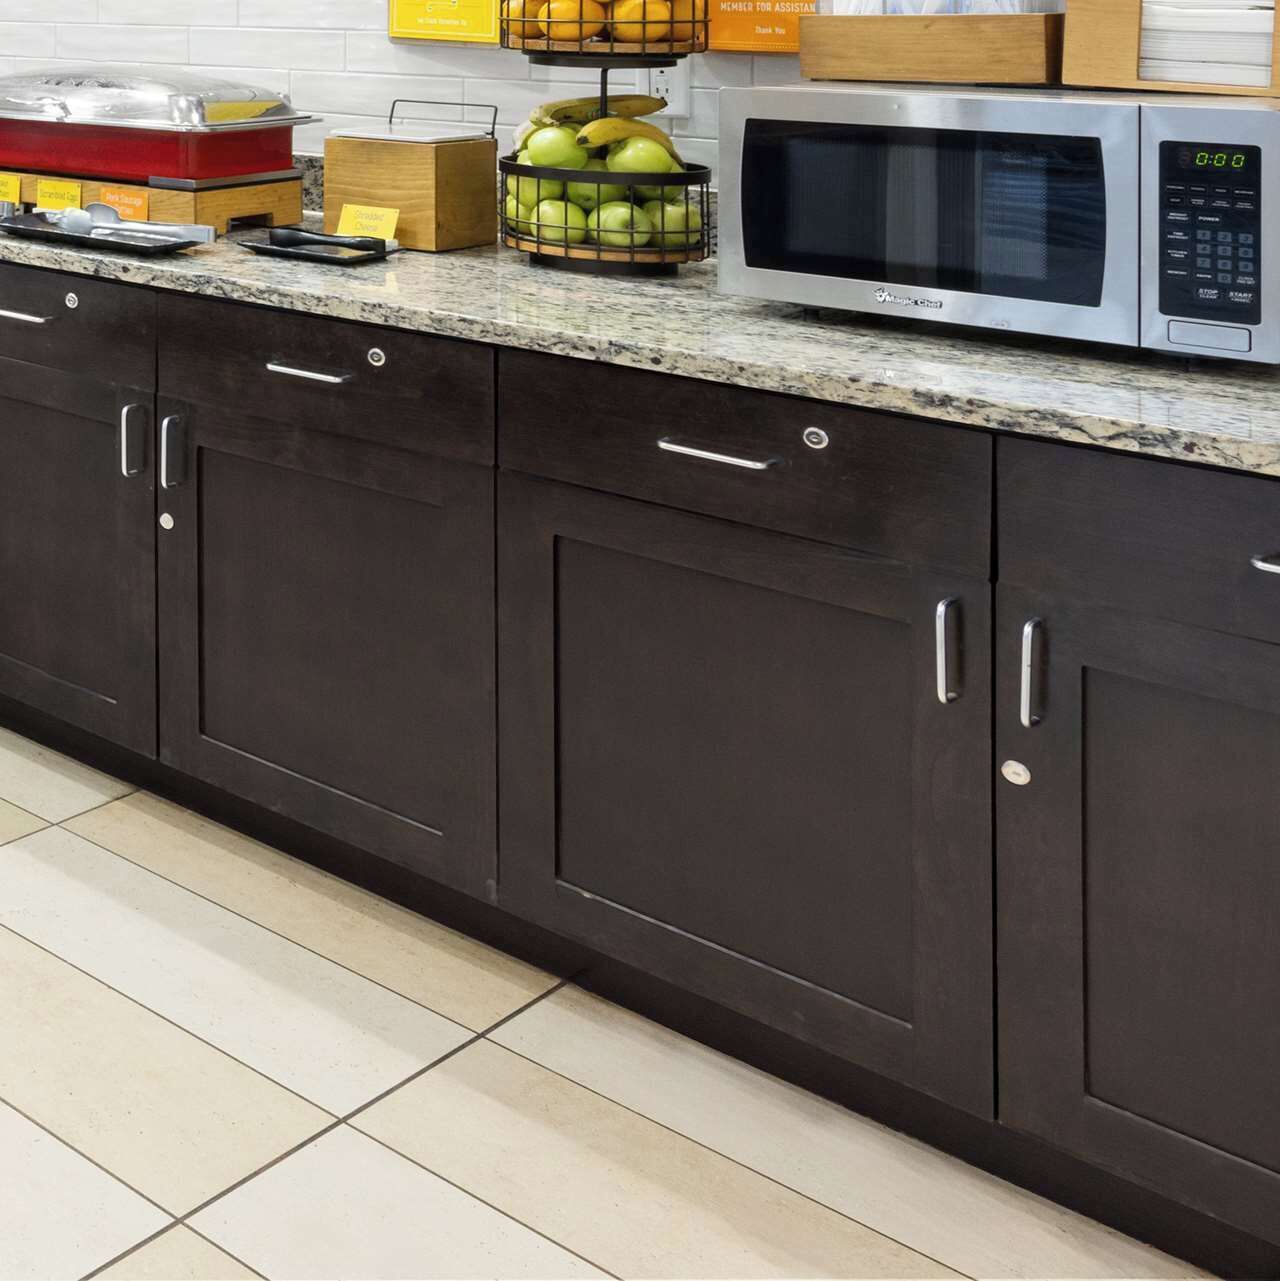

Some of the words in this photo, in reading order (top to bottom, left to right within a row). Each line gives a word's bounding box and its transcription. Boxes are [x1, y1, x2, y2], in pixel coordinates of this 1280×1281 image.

[720, 2, 753, 12] MEMBER
[756, 2, 772, 12] FOR
[775, 2, 817, 13] ASSISTAN
[755, 25, 772, 34] Thank
[775, 25, 786, 34] You
[1196, 152, 1245, 167] 0:00
[885, 294, 916, 306] Magic
[918, 299, 943, 309] Chef
